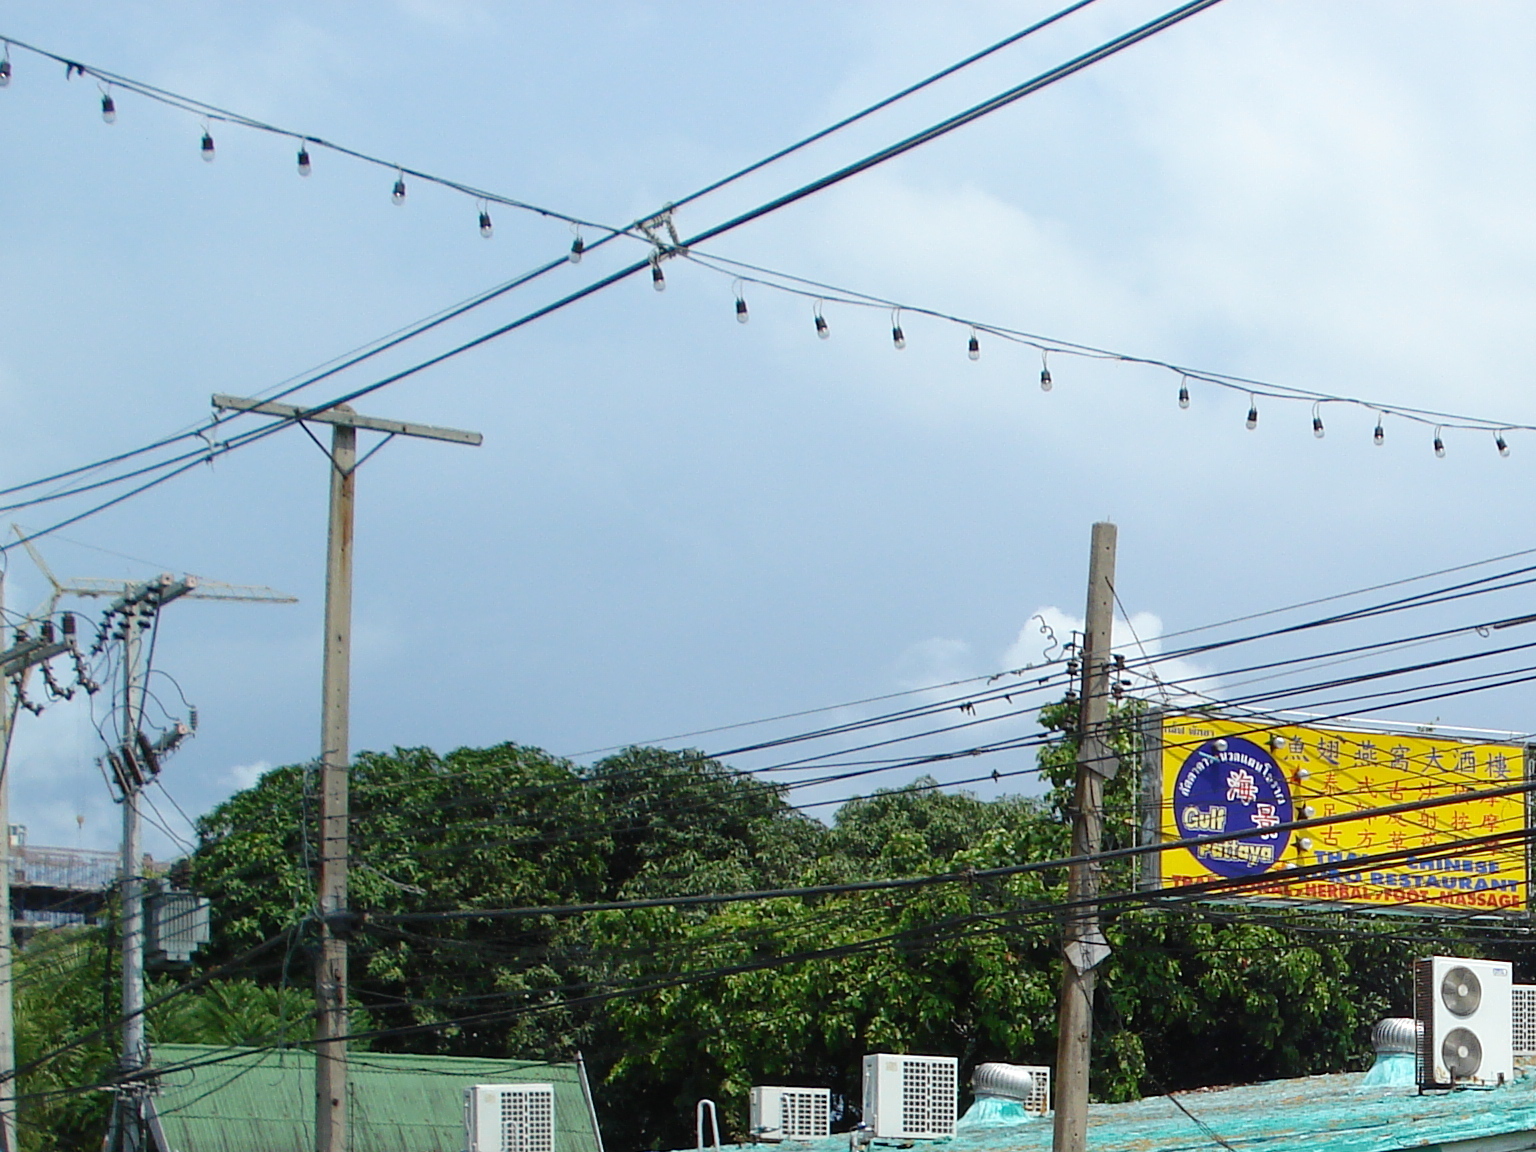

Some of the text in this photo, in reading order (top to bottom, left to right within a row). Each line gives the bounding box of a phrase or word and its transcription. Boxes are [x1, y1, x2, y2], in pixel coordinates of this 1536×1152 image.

[1182, 805, 1226, 832] Gulf
[1197, 836, 1274, 867] Pattaya
[1407, 856, 1499, 873] CHINESE
[1371, 872, 1519, 892] RESTAURANT
[1439, 891, 1520, 908] MASSAGE
